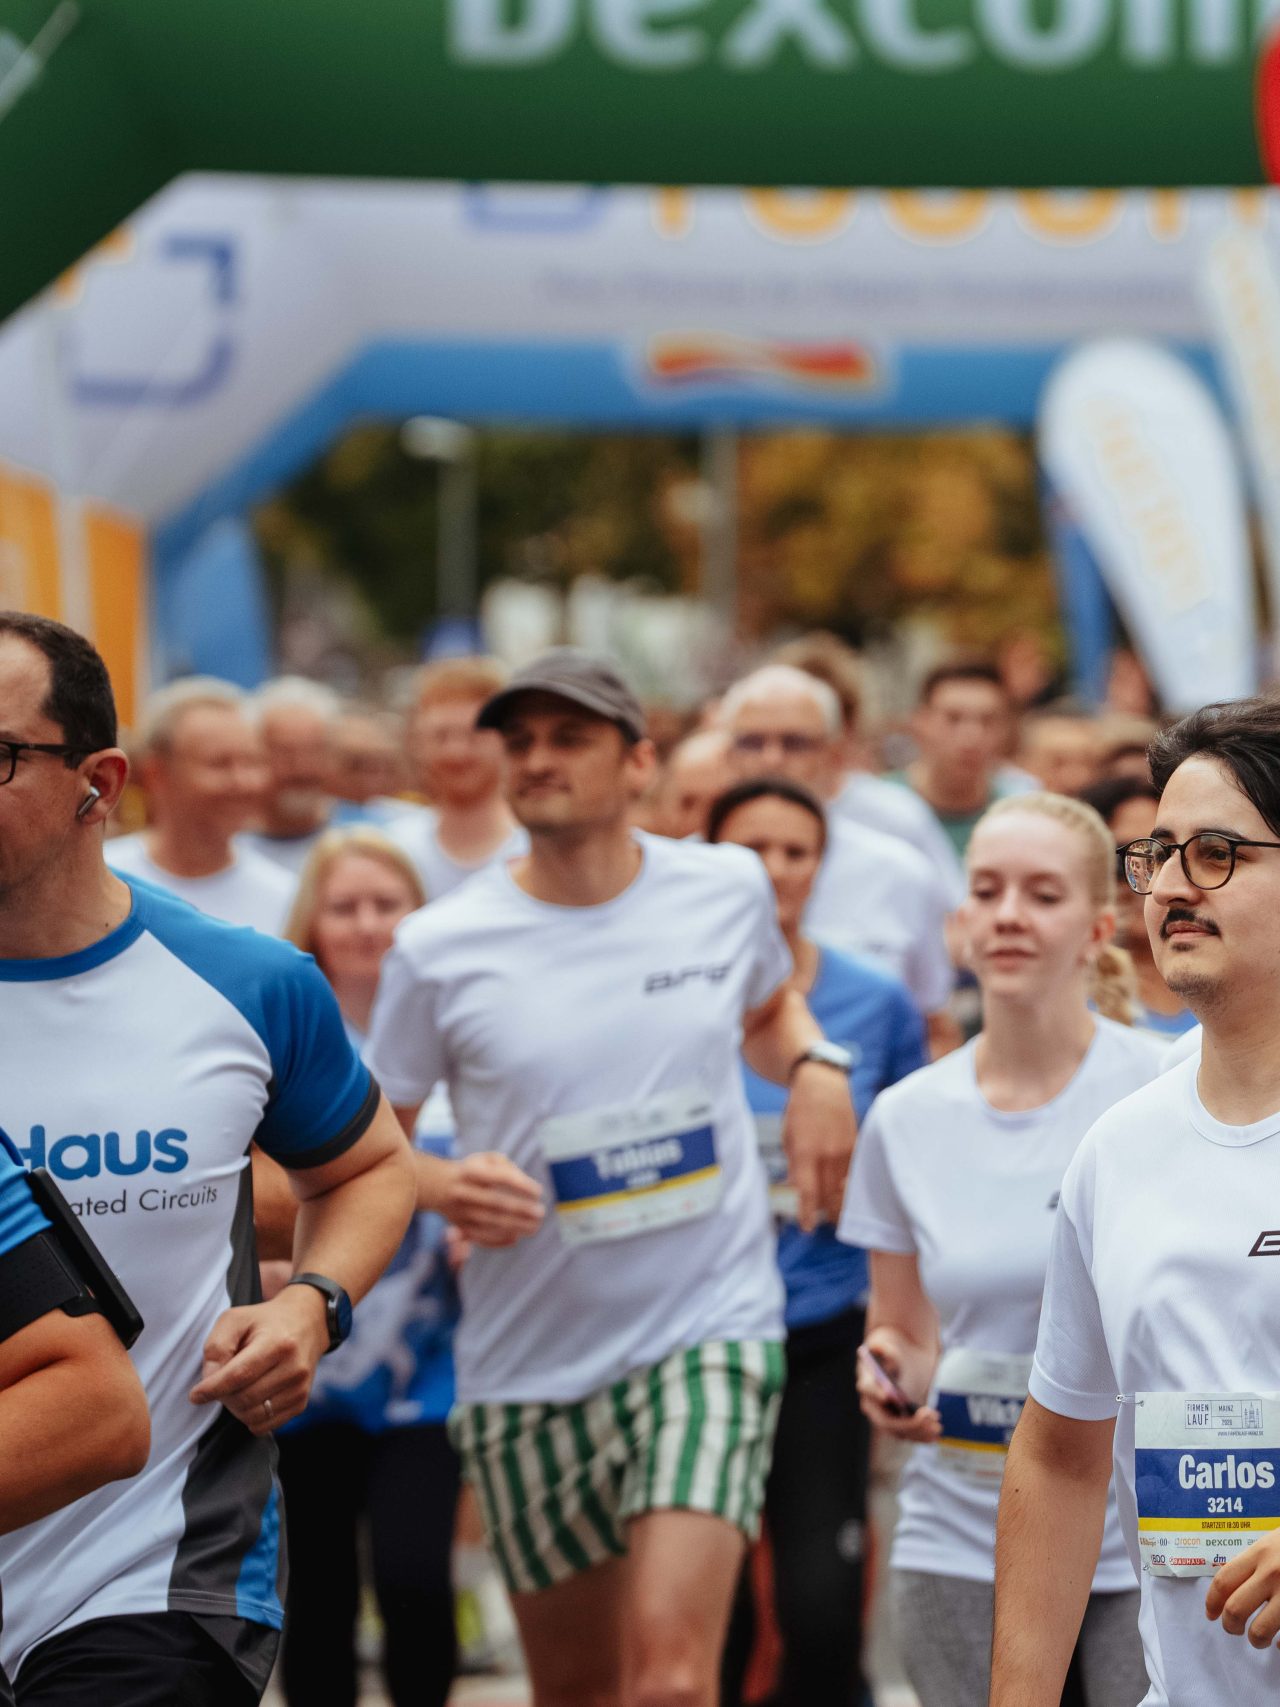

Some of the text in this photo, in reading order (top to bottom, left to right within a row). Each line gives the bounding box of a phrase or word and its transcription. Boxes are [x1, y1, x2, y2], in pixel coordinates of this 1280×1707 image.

[70, 1184, 217, 1216] ated Circuits
[1187, 1403, 1209, 1412] FIRMEN
[1187, 1414, 1209, 1426] LAUF
[1178, 1454, 1276, 1490] Carlos
[1207, 1497, 1243, 1513] 3214
[1201, 1521, 1226, 1529] STARTZEIT
[1240, 1521, 1251, 1529] UHR
[1205, 1538, 1242, 1546] Dexcom
[1213, 1554, 1227, 1563] dm
